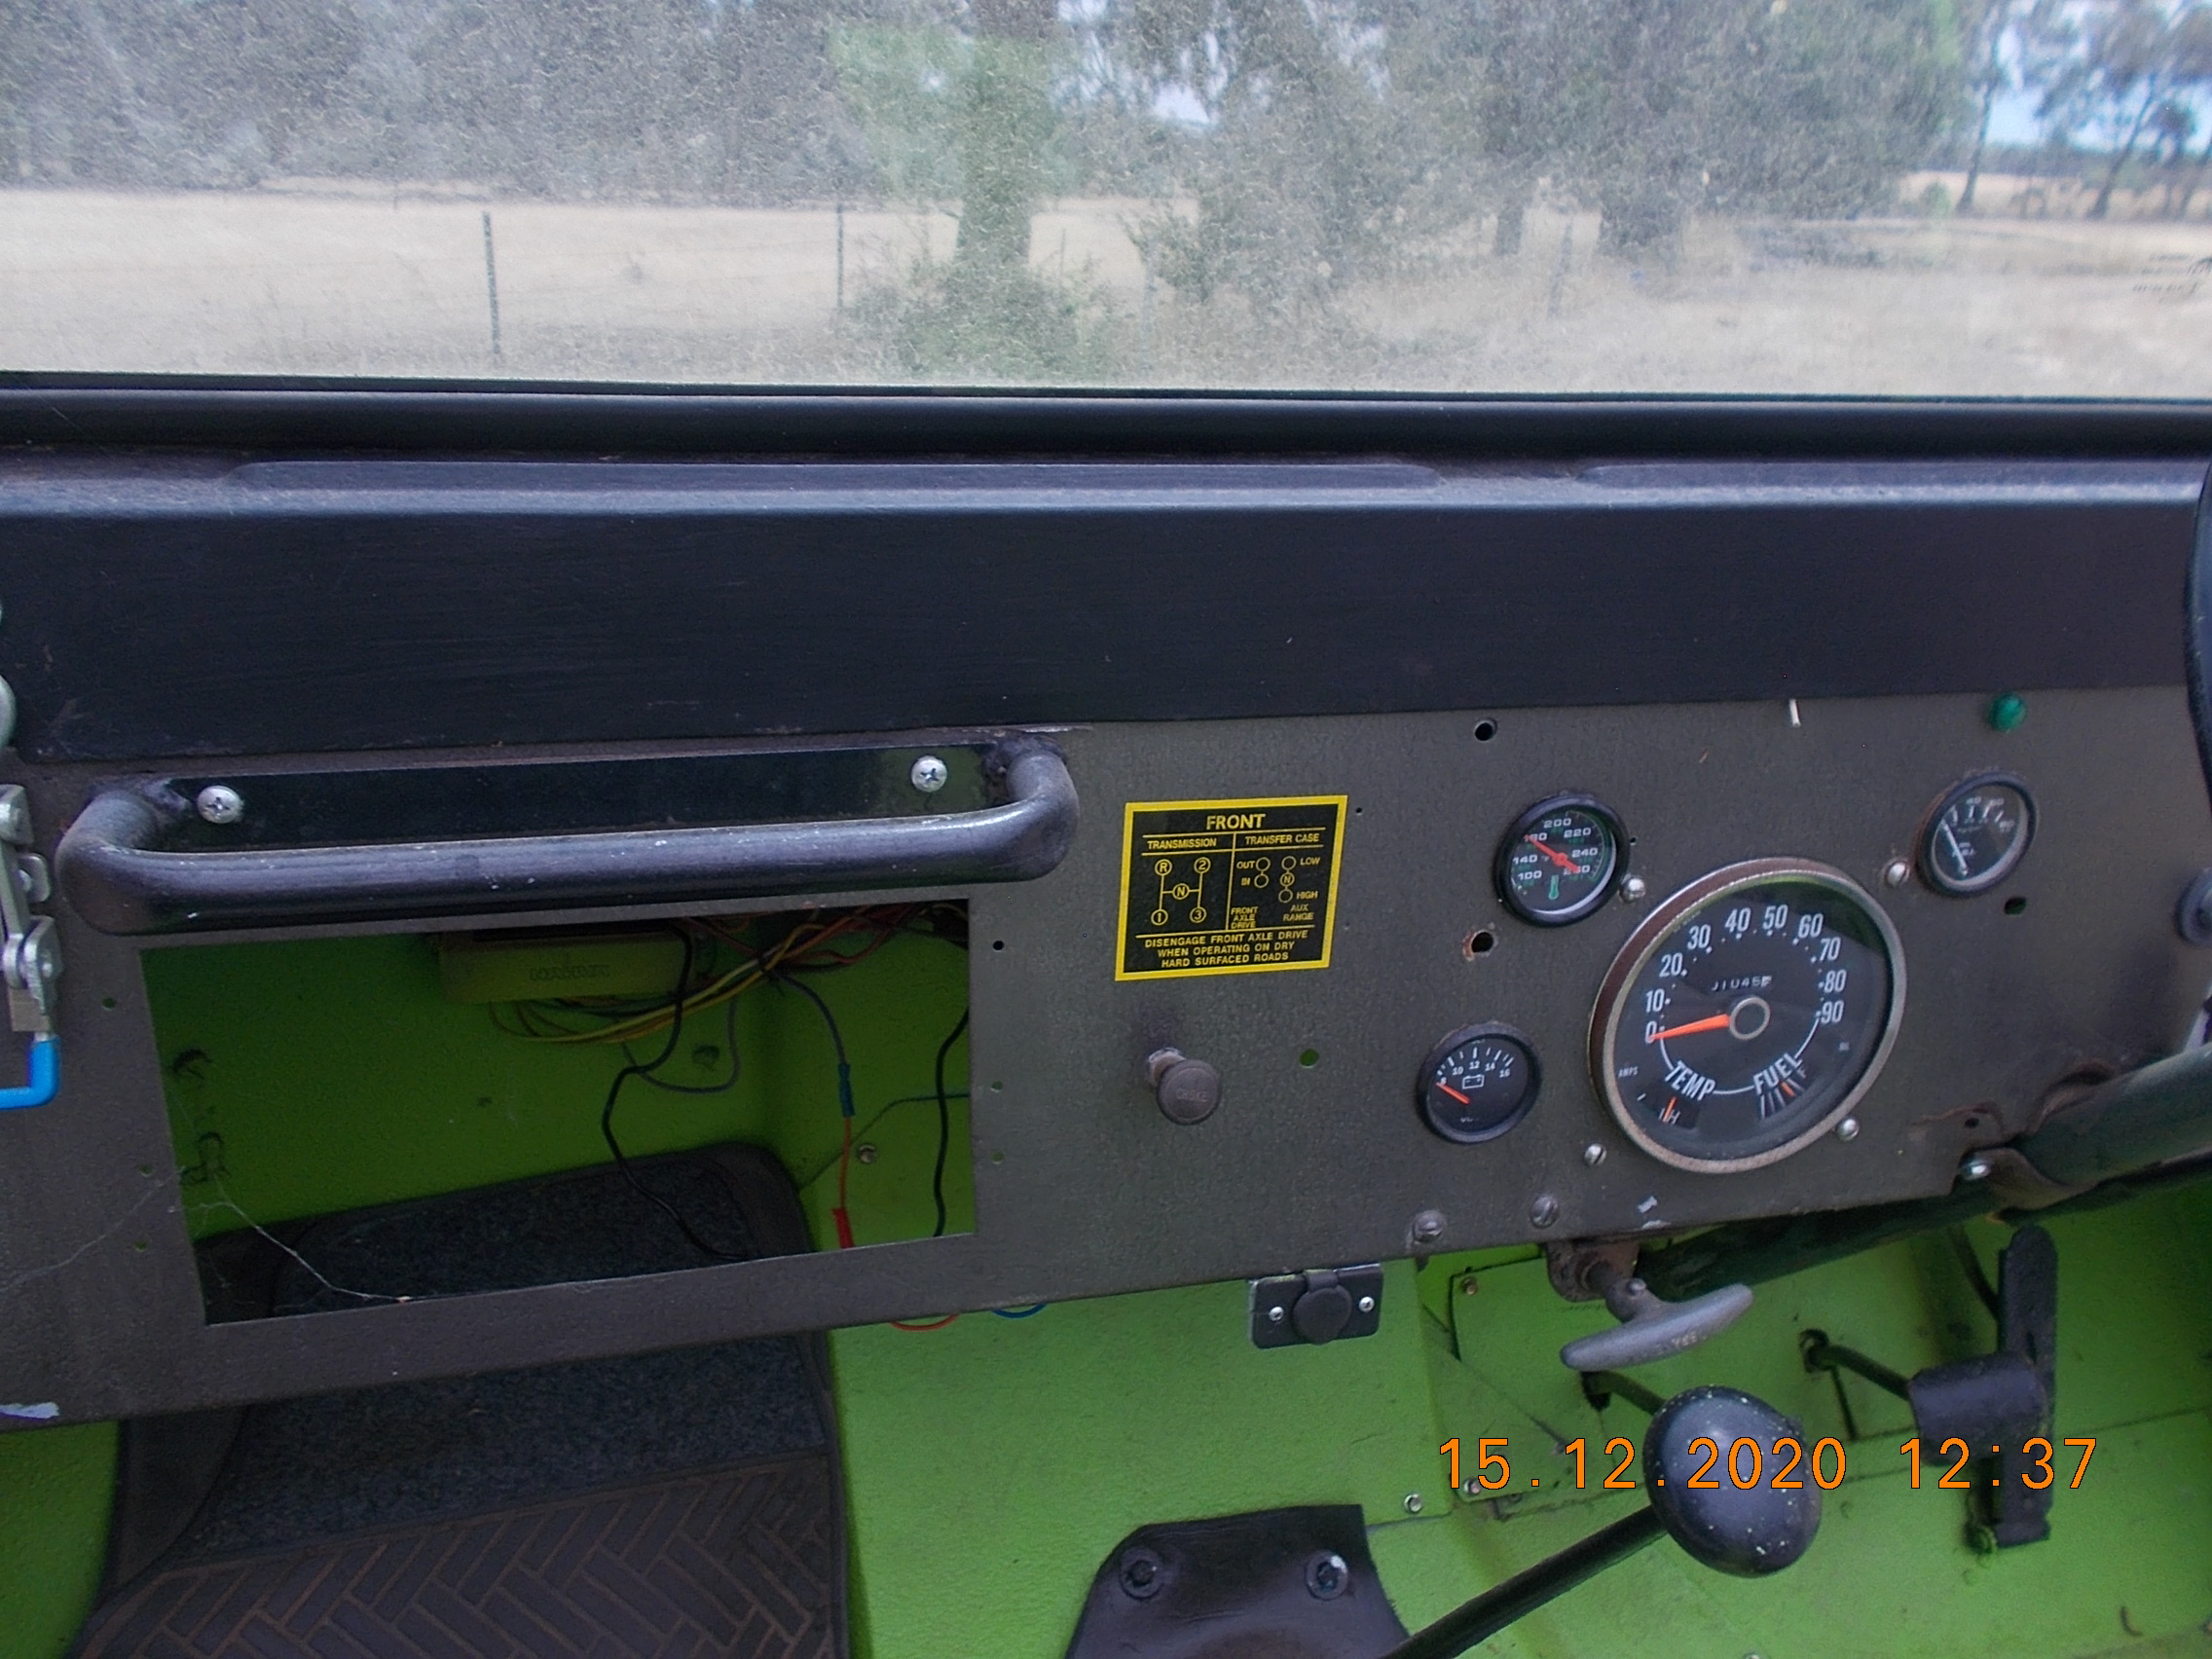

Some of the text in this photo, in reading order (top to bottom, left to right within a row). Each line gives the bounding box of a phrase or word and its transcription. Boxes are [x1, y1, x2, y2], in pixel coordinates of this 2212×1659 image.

[1206, 814, 1266, 830] FRONT
[1543, 818, 1572, 829] 200
[1563, 828, 1592, 838] 220
[1147, 838, 1217, 849] TRANSMISSION
[1245, 833, 1320, 845] TRANSFER CASE
[1571, 847, 1598, 858] 240
[1198, 861, 1206, 870] 2
[1236, 861, 1255, 869] OUT
[1300, 857, 1320, 866] LOW
[1513, 854, 1538, 866] 140
[1159, 863, 1168, 872] R
[1283, 875, 1292, 884] N
[1517, 870, 1542, 881] 100
[1241, 877, 1251, 886] IN
[1176, 887, 1186, 897] N
[1296, 891, 1318, 900] HIGH
[1231, 906, 1258, 915] FRONT
[1290, 903, 1309, 912] AUX
[1195, 910, 1202, 920] 3
[1234, 913, 1255, 922] AXLE
[1282, 912, 1314, 922] RANGE
[1724, 907, 1751, 932] 40
[1762, 904, 1788, 930] 50
[1797, 913, 1824, 938] 60
[1145, 930, 1309, 948] DISENGAGE FRONT AXLE DRIVE
[1687, 925, 1711, 949] 30
[1158, 941, 1295, 957] WHEN OPERATING ON DRY
[1819, 938, 1841, 962] 70
[1161, 951, 1289, 968] HARD SURFACED ROADS
[1659, 953, 1683, 977] 20
[1823, 970, 1847, 993] 80
[1645, 989, 1664, 1013] 10
[1820, 1000, 1844, 1023] 90
[1644, 1021, 1657, 1044] 0
[1468, 1060, 1480, 1070] 12
[1485, 1062, 1495, 1072] 14
[1452, 1066, 1463, 1076] 10
[1499, 1068, 1510, 1078] 16
[1617, 1065, 1639, 1078] AMPS
[1752, 1052, 1803, 1094] FUEL
[1664, 1060, 1715, 1102] TEMP
